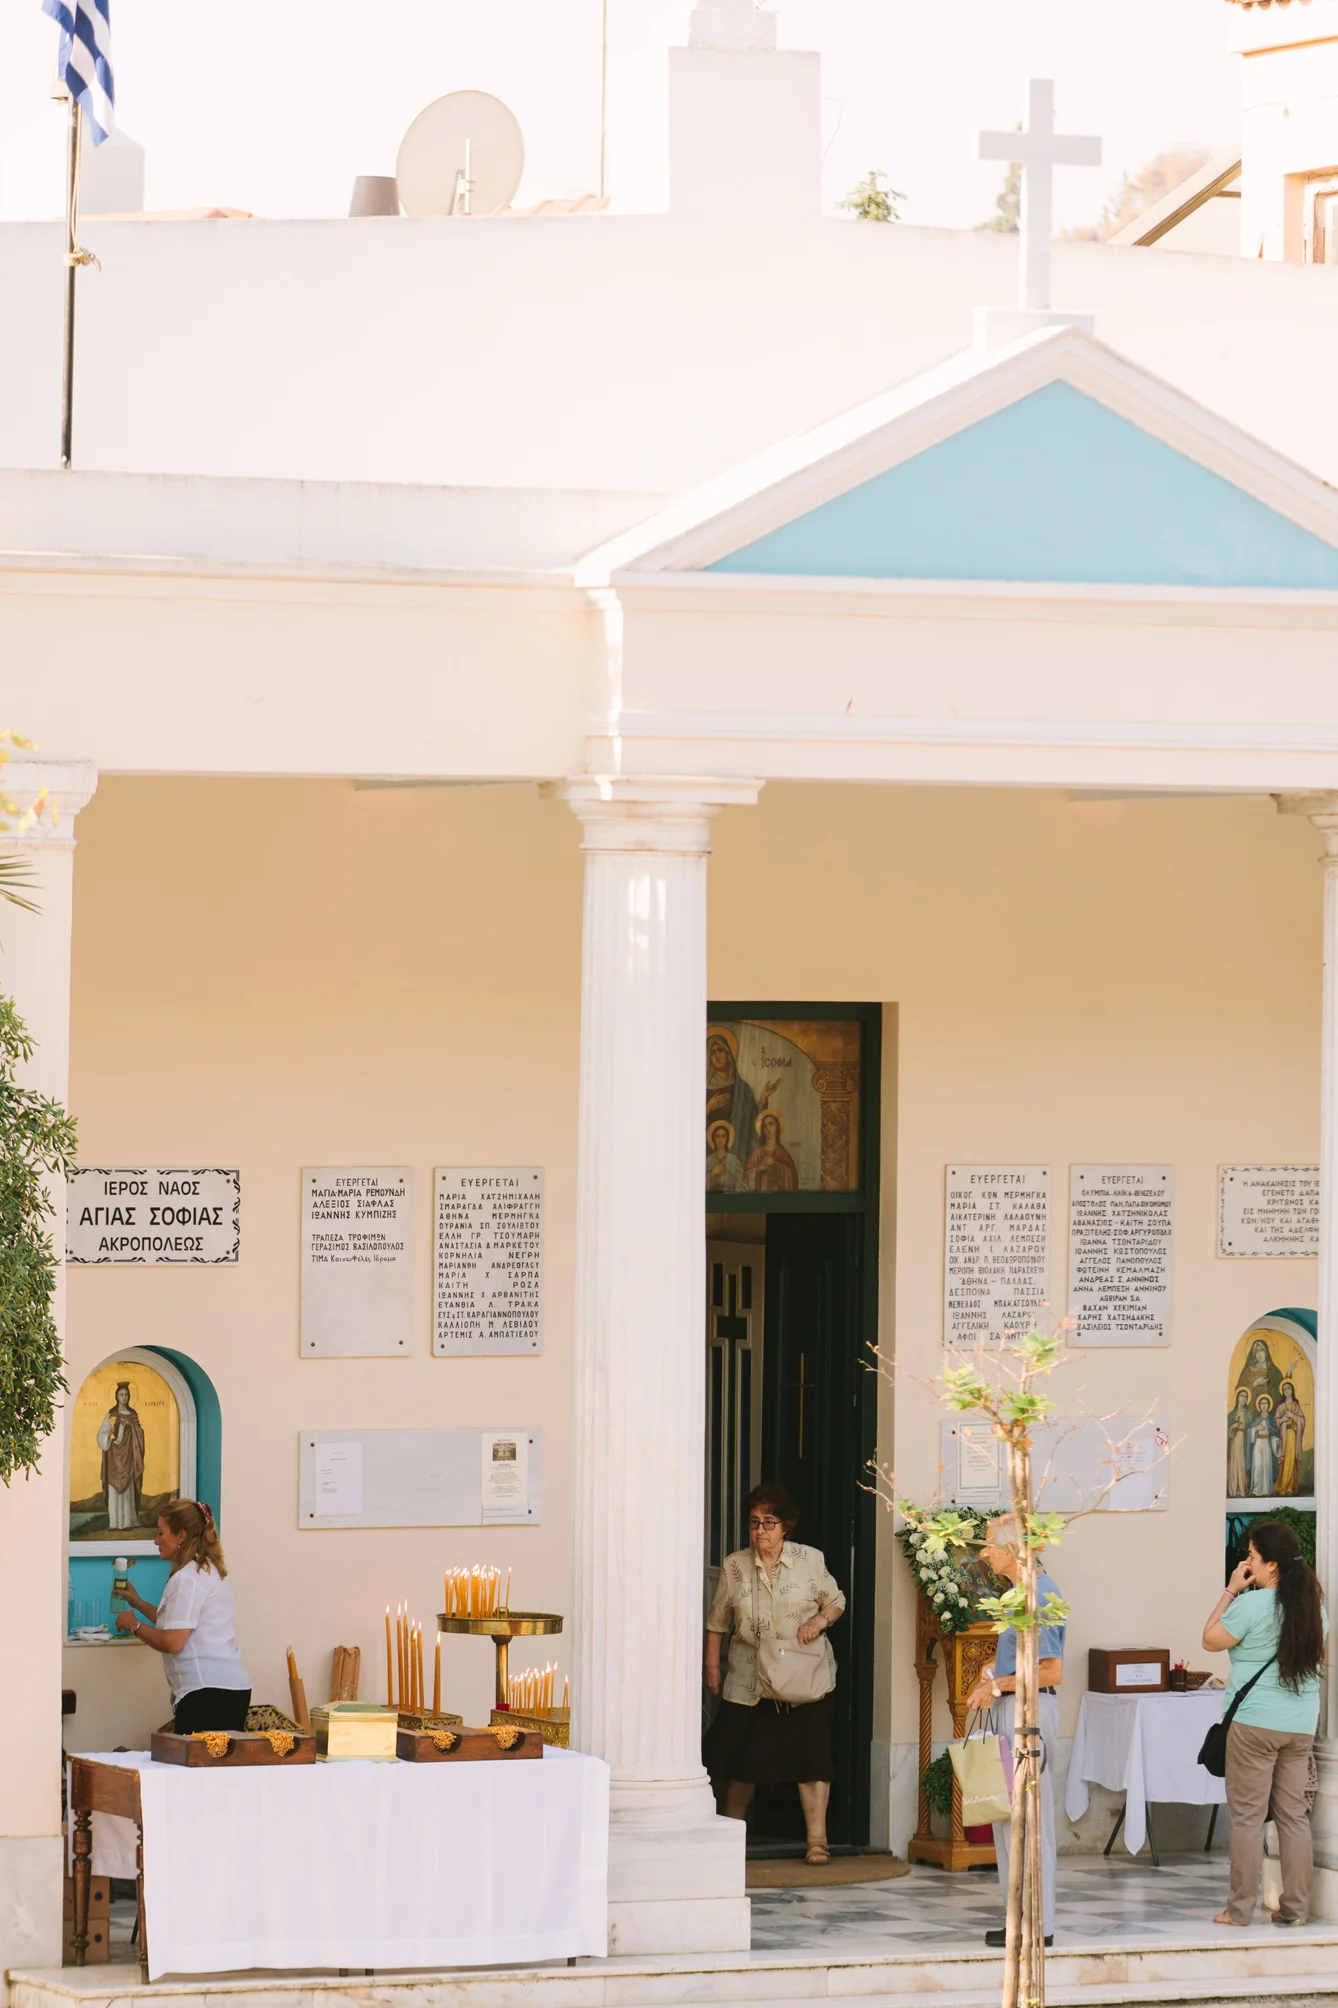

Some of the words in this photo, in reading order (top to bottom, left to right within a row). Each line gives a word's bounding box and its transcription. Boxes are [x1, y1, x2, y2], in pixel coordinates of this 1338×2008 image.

[336, 1178, 378, 1186] ΕΥΕΡΓΕΤΑΙ
[971, 1175, 1025, 1183] ΕΥΕΡΓΕΤΑΙ
[1102, 1176, 1143, 1184] ΕΥΕΡΓΕΤΑΙ
[105, 1182, 148, 1195] ΙΕΡΟΣ
[159, 1182, 200, 1195] ΝΑΟΣ
[313, 1200, 350, 1208] ΑΛΕΞΙΟΣ
[80, 1207, 136, 1225] ΑΓΙΑΣ
[150, 1207, 223, 1225] ΣΟΦΙΑΣ
[312, 1211, 350, 1219] ΙΩΑΝΝΗΣ
[356, 1210, 396, 1218] ΚΥΜΠΙΖΗΣ
[99, 1237, 203, 1251] ΑΚΡΟΠΟΛΕΩΣ
[1004, 1245, 1045, 1253] ΛΑΖΑΡΟΥ
[949, 1288, 990, 1296] ΔΕΣΠΟΙΝΑ
[949, 1300, 980, 1308] ΜΕΝΕΛΑΟΣ
